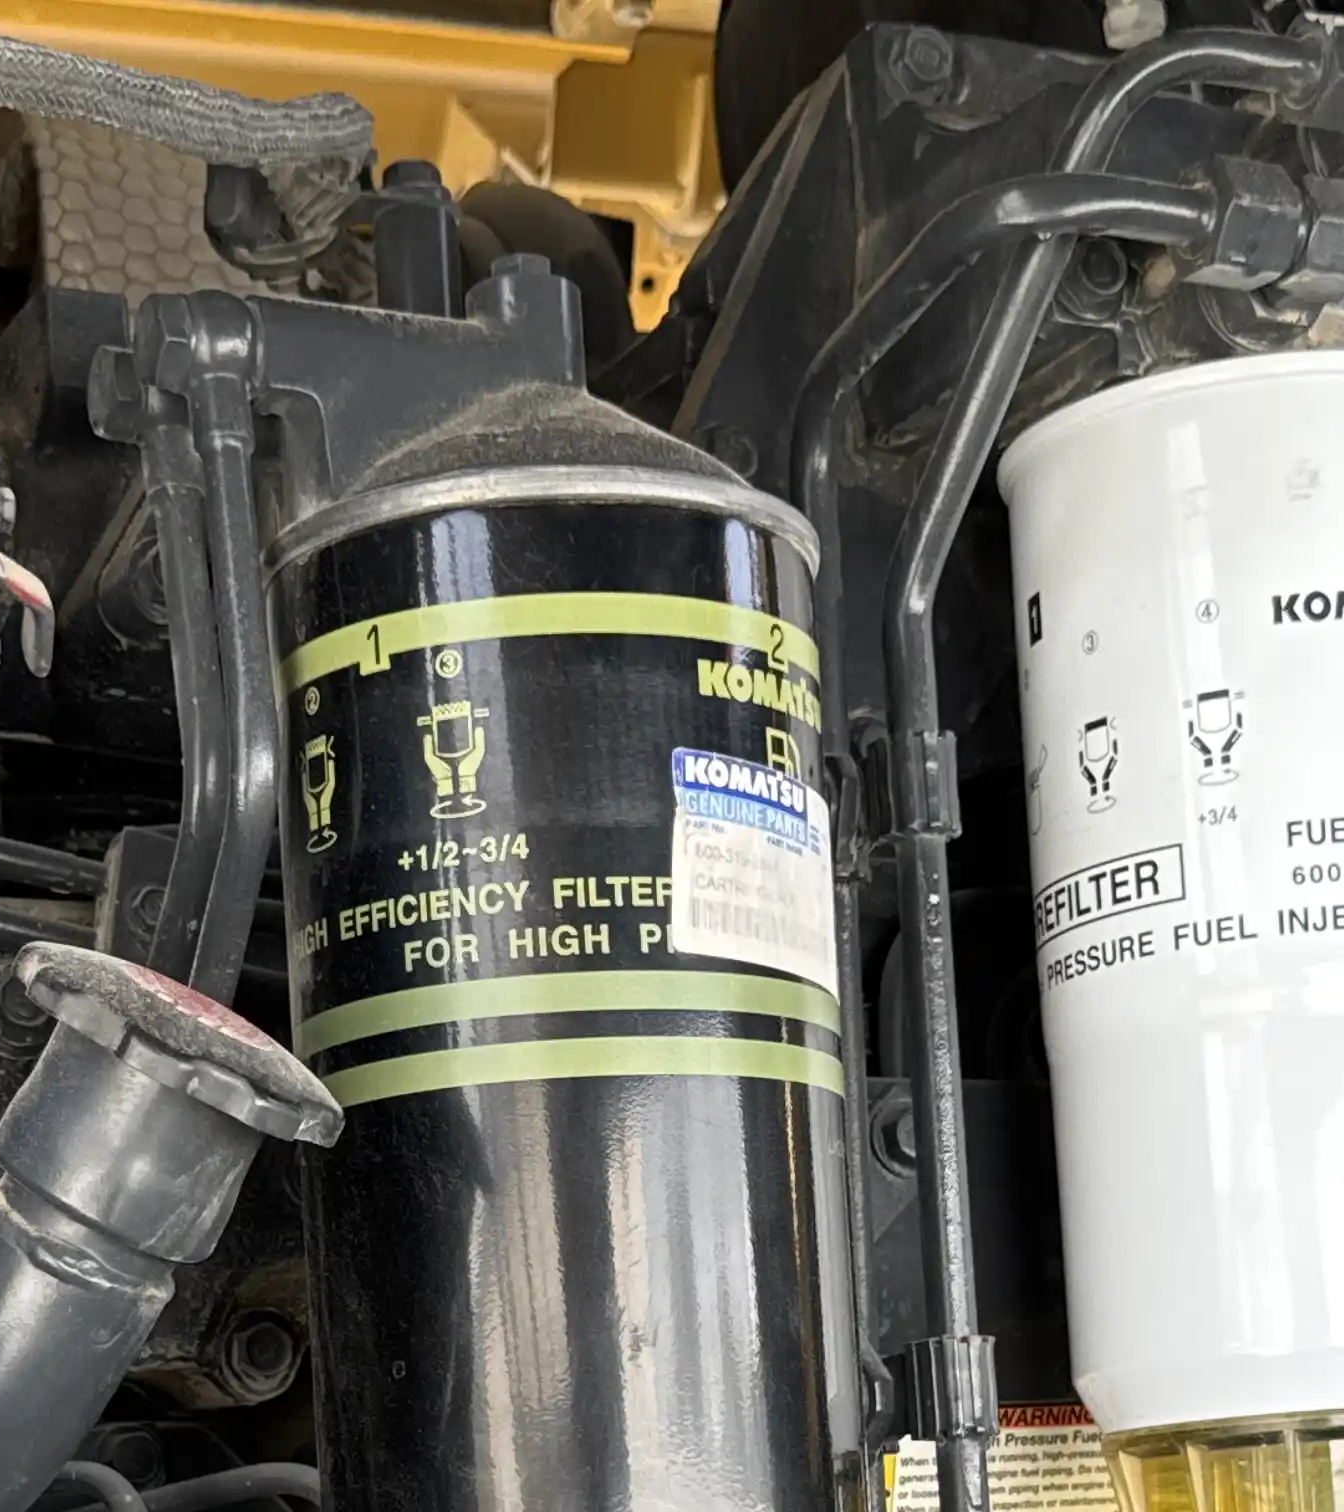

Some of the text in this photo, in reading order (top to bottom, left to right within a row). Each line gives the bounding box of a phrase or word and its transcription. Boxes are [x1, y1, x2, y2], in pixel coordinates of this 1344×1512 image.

[367, 624, 380, 665] 1
[770, 624, 785, 664] 2
[684, 755, 804, 812] KOMATSU
[686, 790, 765, 824] GENUINE
[767, 808, 805, 842] PARTS
[340, 881, 529, 940] EFFICIENCY
[1035, 859, 1160, 942] REFILTER
[404, 934, 480, 972] FOR
[509, 924, 610, 959] HIGH
[1047, 930, 1155, 990] PRESSURE
[1174, 914, 1258, 951] FUEL
[1005, 1433, 1068, 1447] Pressure
